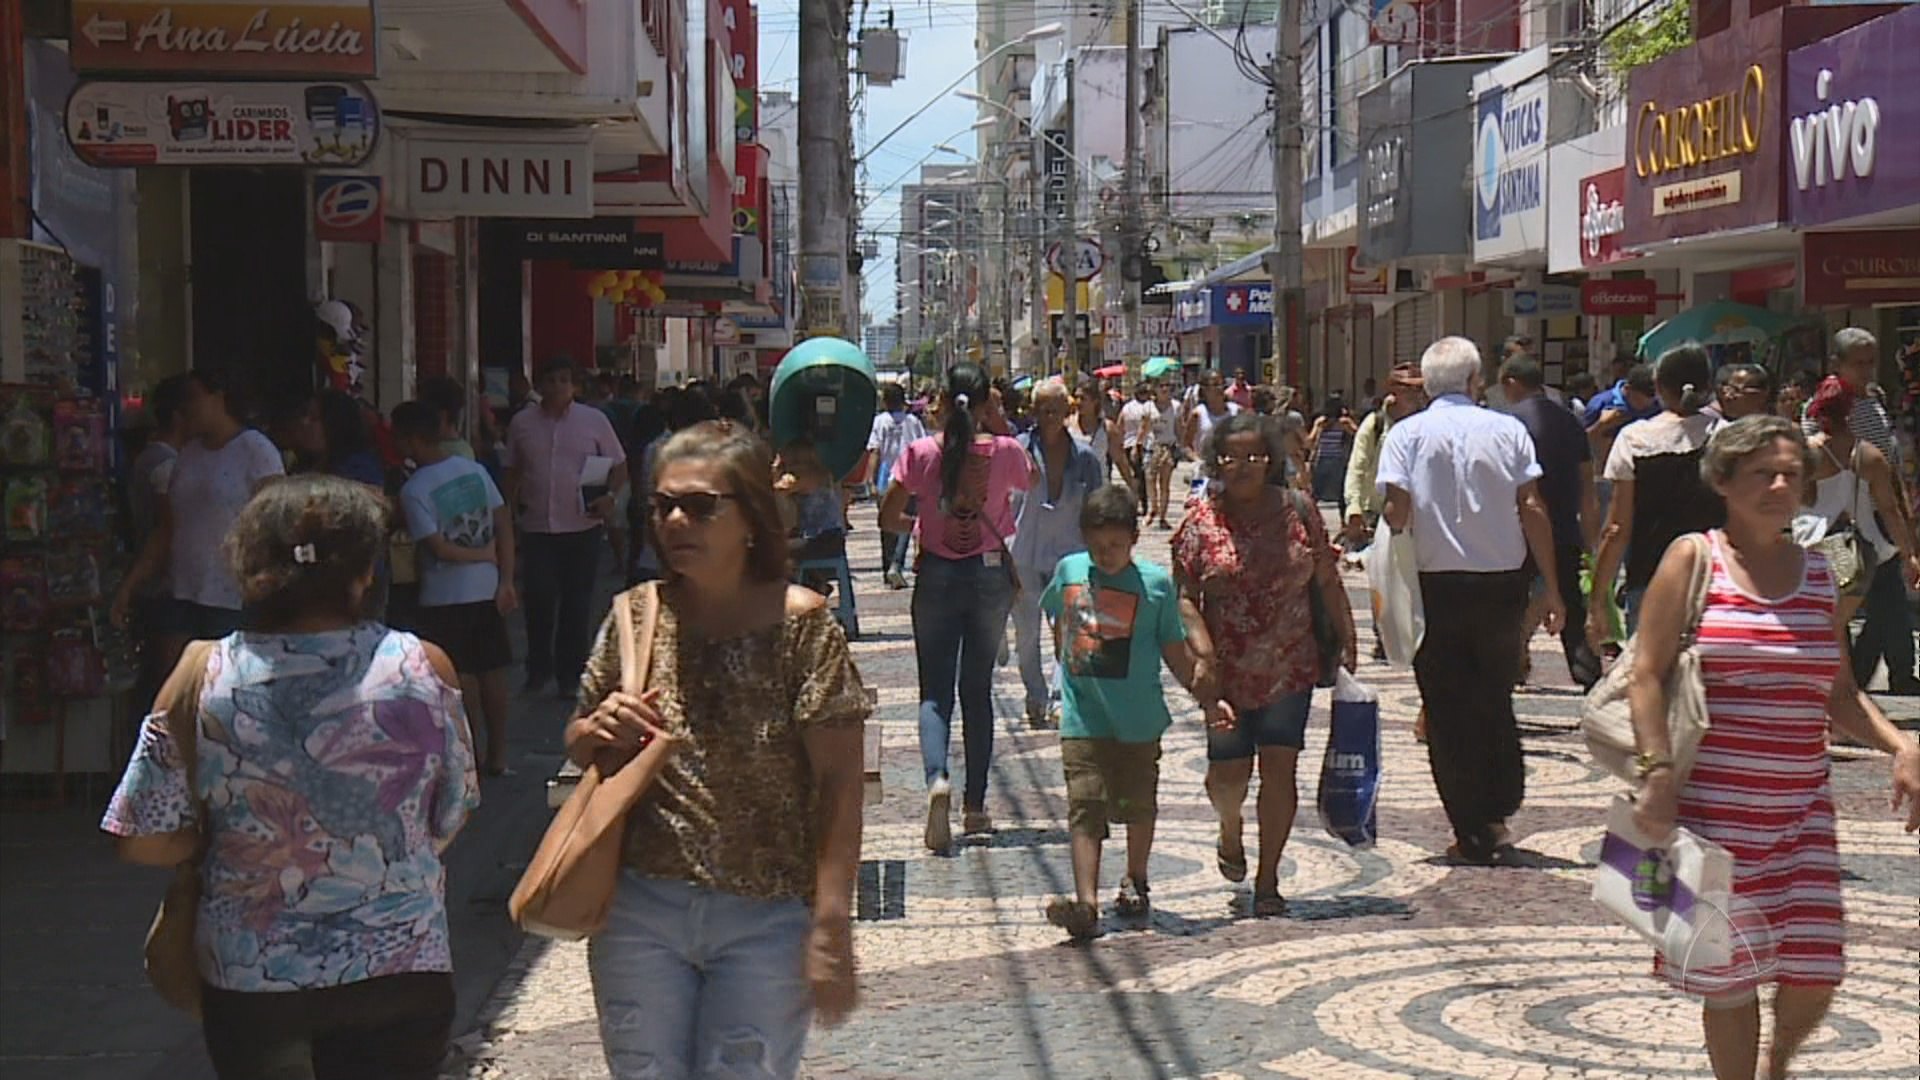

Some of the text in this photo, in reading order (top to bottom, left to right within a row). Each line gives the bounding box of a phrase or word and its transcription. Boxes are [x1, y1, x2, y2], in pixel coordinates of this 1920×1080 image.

[133, 7, 363, 54] Ana Lúcia
[232, 107, 288, 119] CARIMBOS
[212, 119, 292, 141] LIDER
[1791, 69, 1880, 190] vivo
[420, 158, 571, 194] DINNI
[526, 232, 627, 244] DI SANTINNI
[632, 247, 658, 257] NNI
